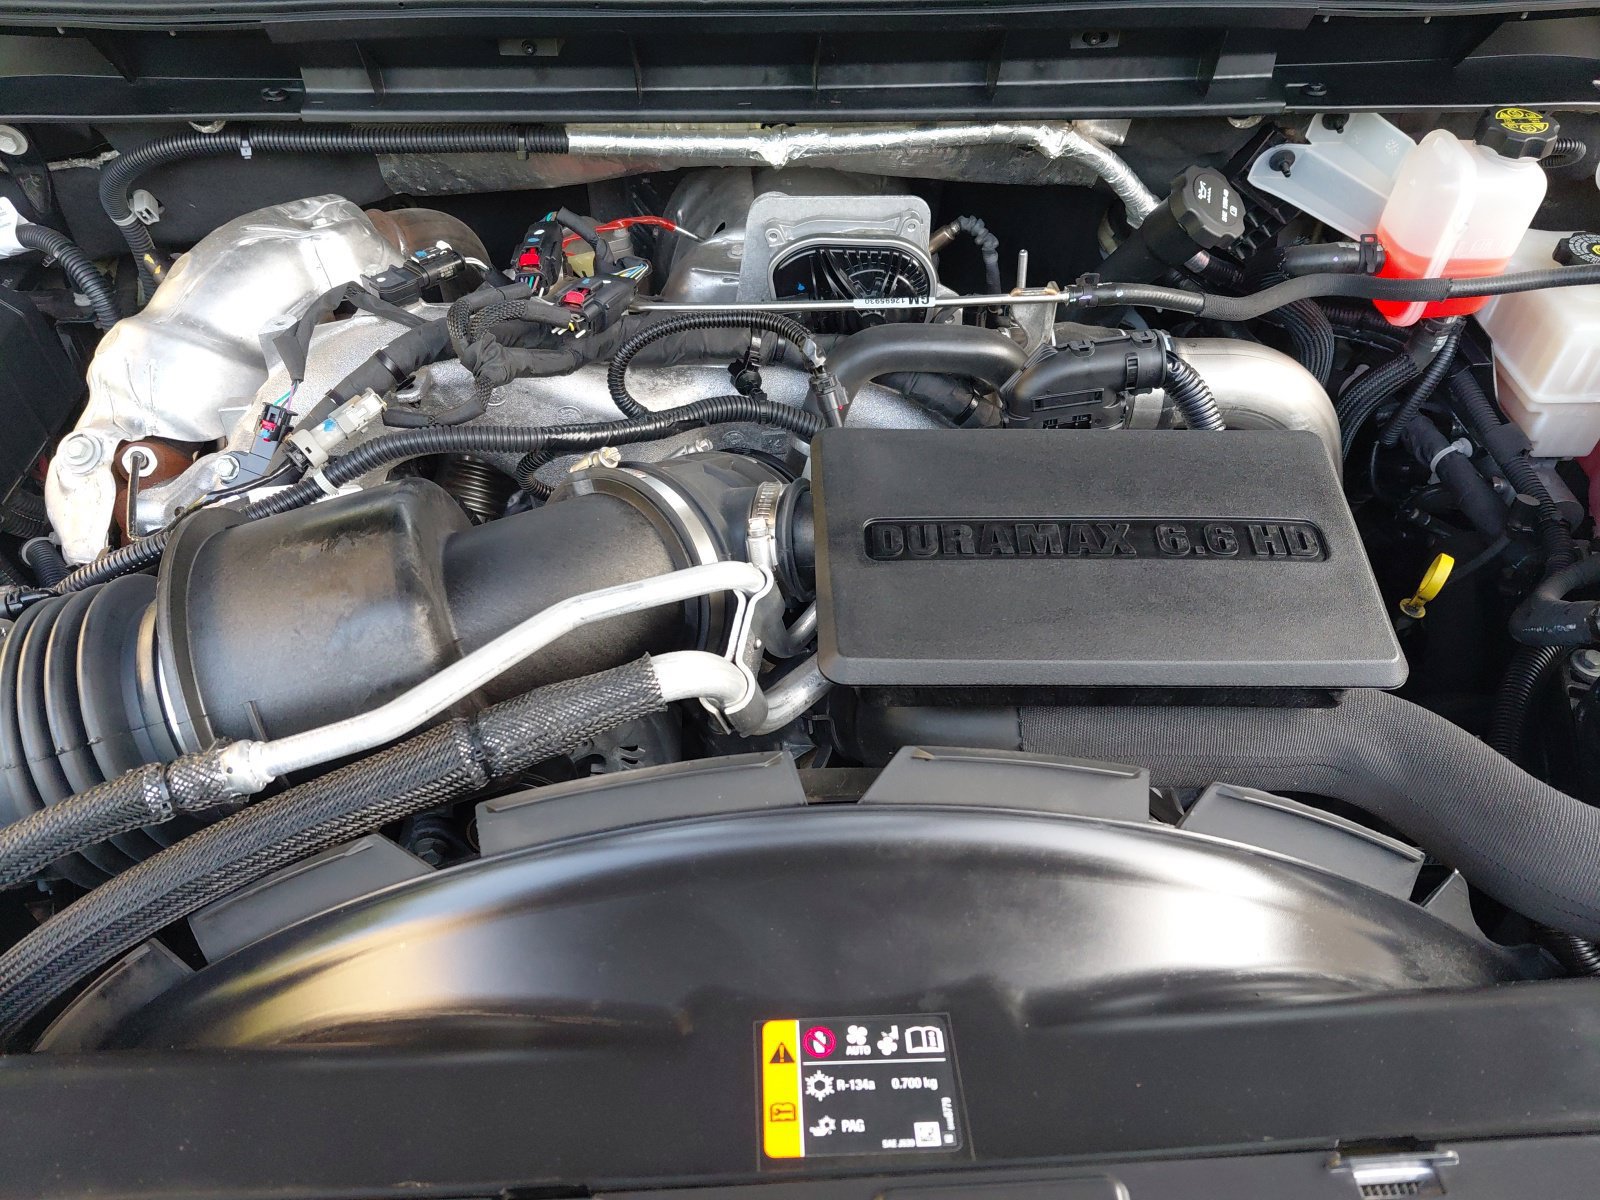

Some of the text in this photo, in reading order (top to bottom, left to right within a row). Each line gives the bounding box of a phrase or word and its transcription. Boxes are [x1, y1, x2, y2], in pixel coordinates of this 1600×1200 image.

[909, 296, 930, 305] GM
[873, 522, 1321, 558] DURAMAX 6.6 HD
[846, 1045, 871, 1056] AUTO
[836, 1077, 938, 1091] R-134a 0.700 kg
[841, 1119, 866, 1133] PAG
